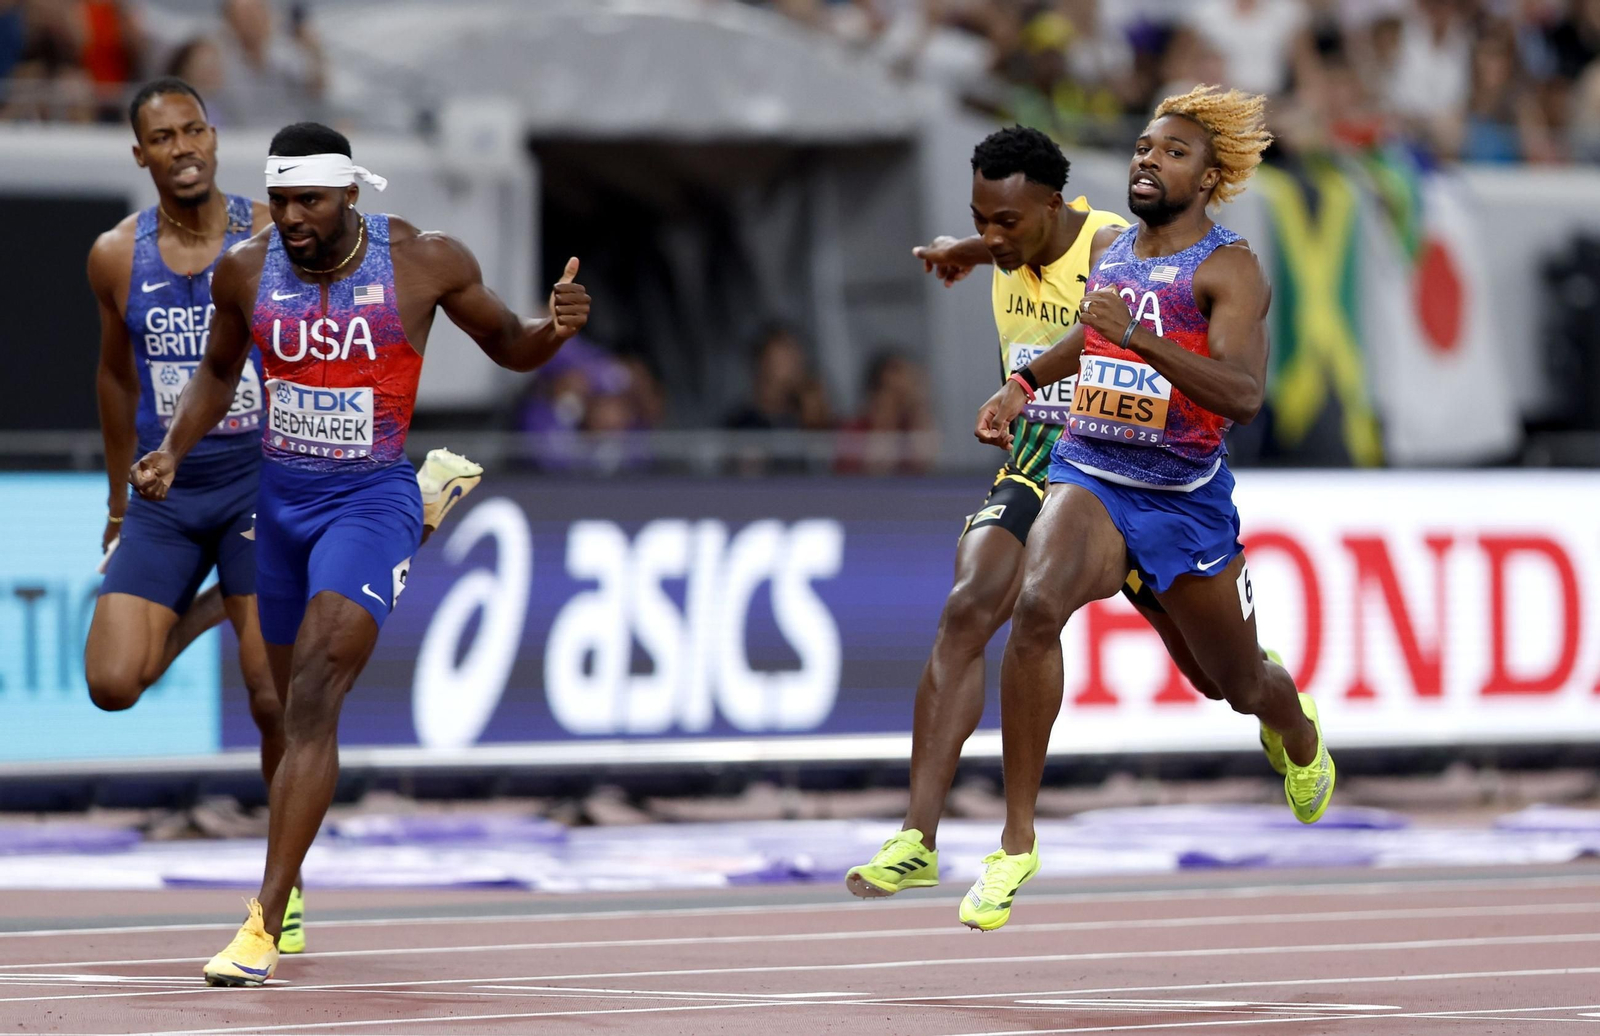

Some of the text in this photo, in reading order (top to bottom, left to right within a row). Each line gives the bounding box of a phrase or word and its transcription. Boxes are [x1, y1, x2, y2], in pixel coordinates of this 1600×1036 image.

[145, 303, 216, 333] GREA
[145, 330, 210, 356] BRIT
[272, 316, 376, 362] USA
[1095, 361, 1162, 395] TDK
[291, 386, 365, 413] TDK
[1028, 409, 1070, 420] TOKY
[1076, 388, 1153, 423] LYLES
[273, 406, 367, 441] BEDNAREK
[1138, 431, 1158, 443] 25
[347, 449, 367, 458] 25
[1244, 568, 1253, 604] 6
[544, 518, 845, 735] asics
[1072, 525, 1600, 708] HOND
